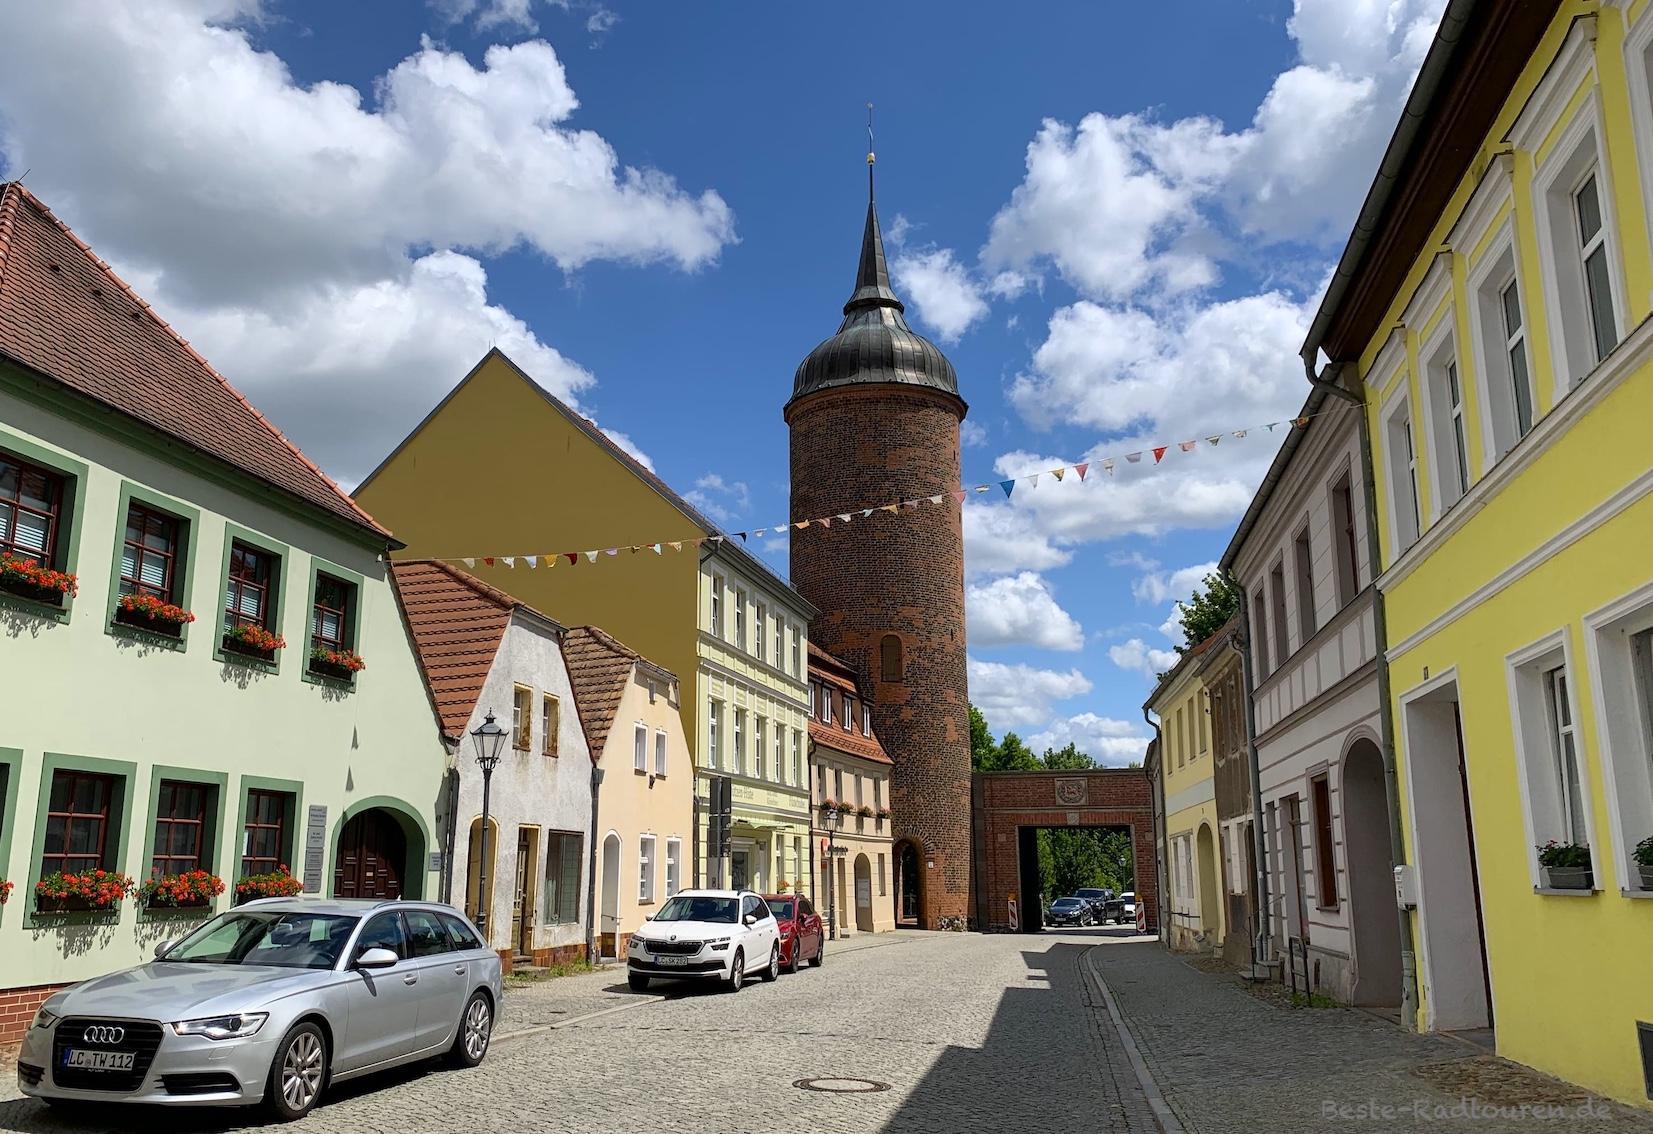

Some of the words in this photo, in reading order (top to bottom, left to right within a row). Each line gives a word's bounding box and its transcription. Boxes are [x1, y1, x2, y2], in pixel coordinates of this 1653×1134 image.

[69, 1051, 84, 1065] LC
[92, 1053, 108, 1067] TW
[109, 1054, 133, 1069] 112
